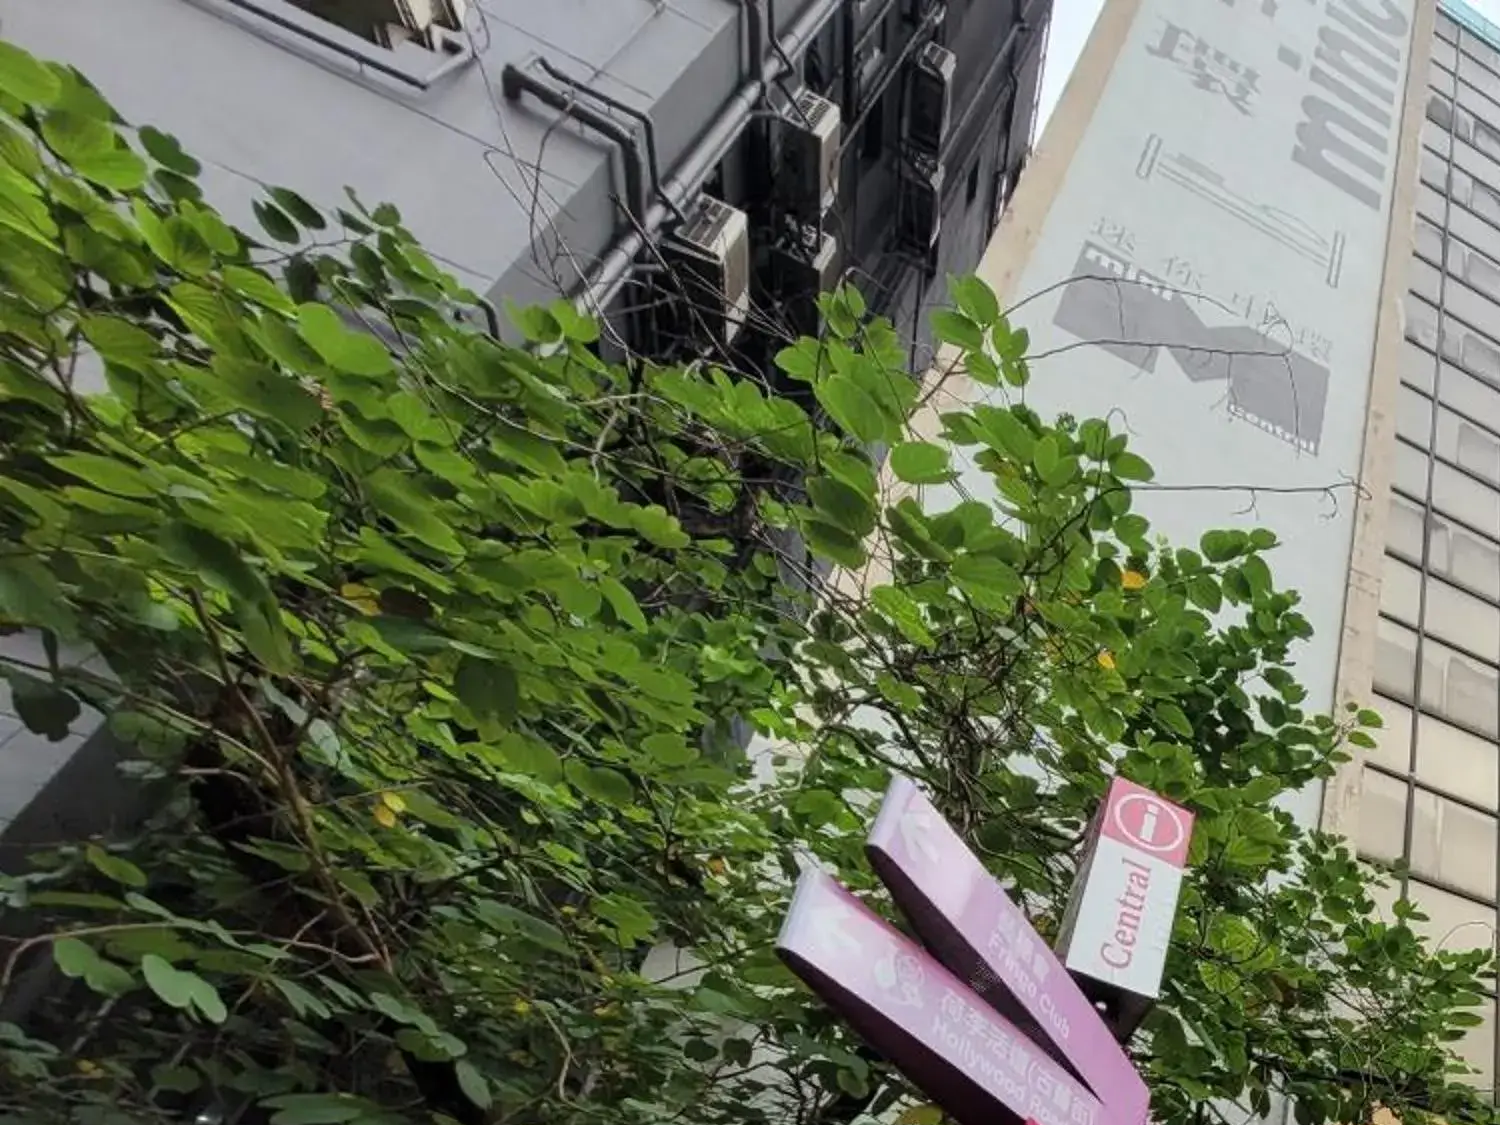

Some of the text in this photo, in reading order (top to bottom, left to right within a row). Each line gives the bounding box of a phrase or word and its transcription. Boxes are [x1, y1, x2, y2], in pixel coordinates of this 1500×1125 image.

[1101, 857, 1152, 968] Central
[1038, 993, 1070, 1039] Club
[932, 1018, 1026, 1102] Hollywood
